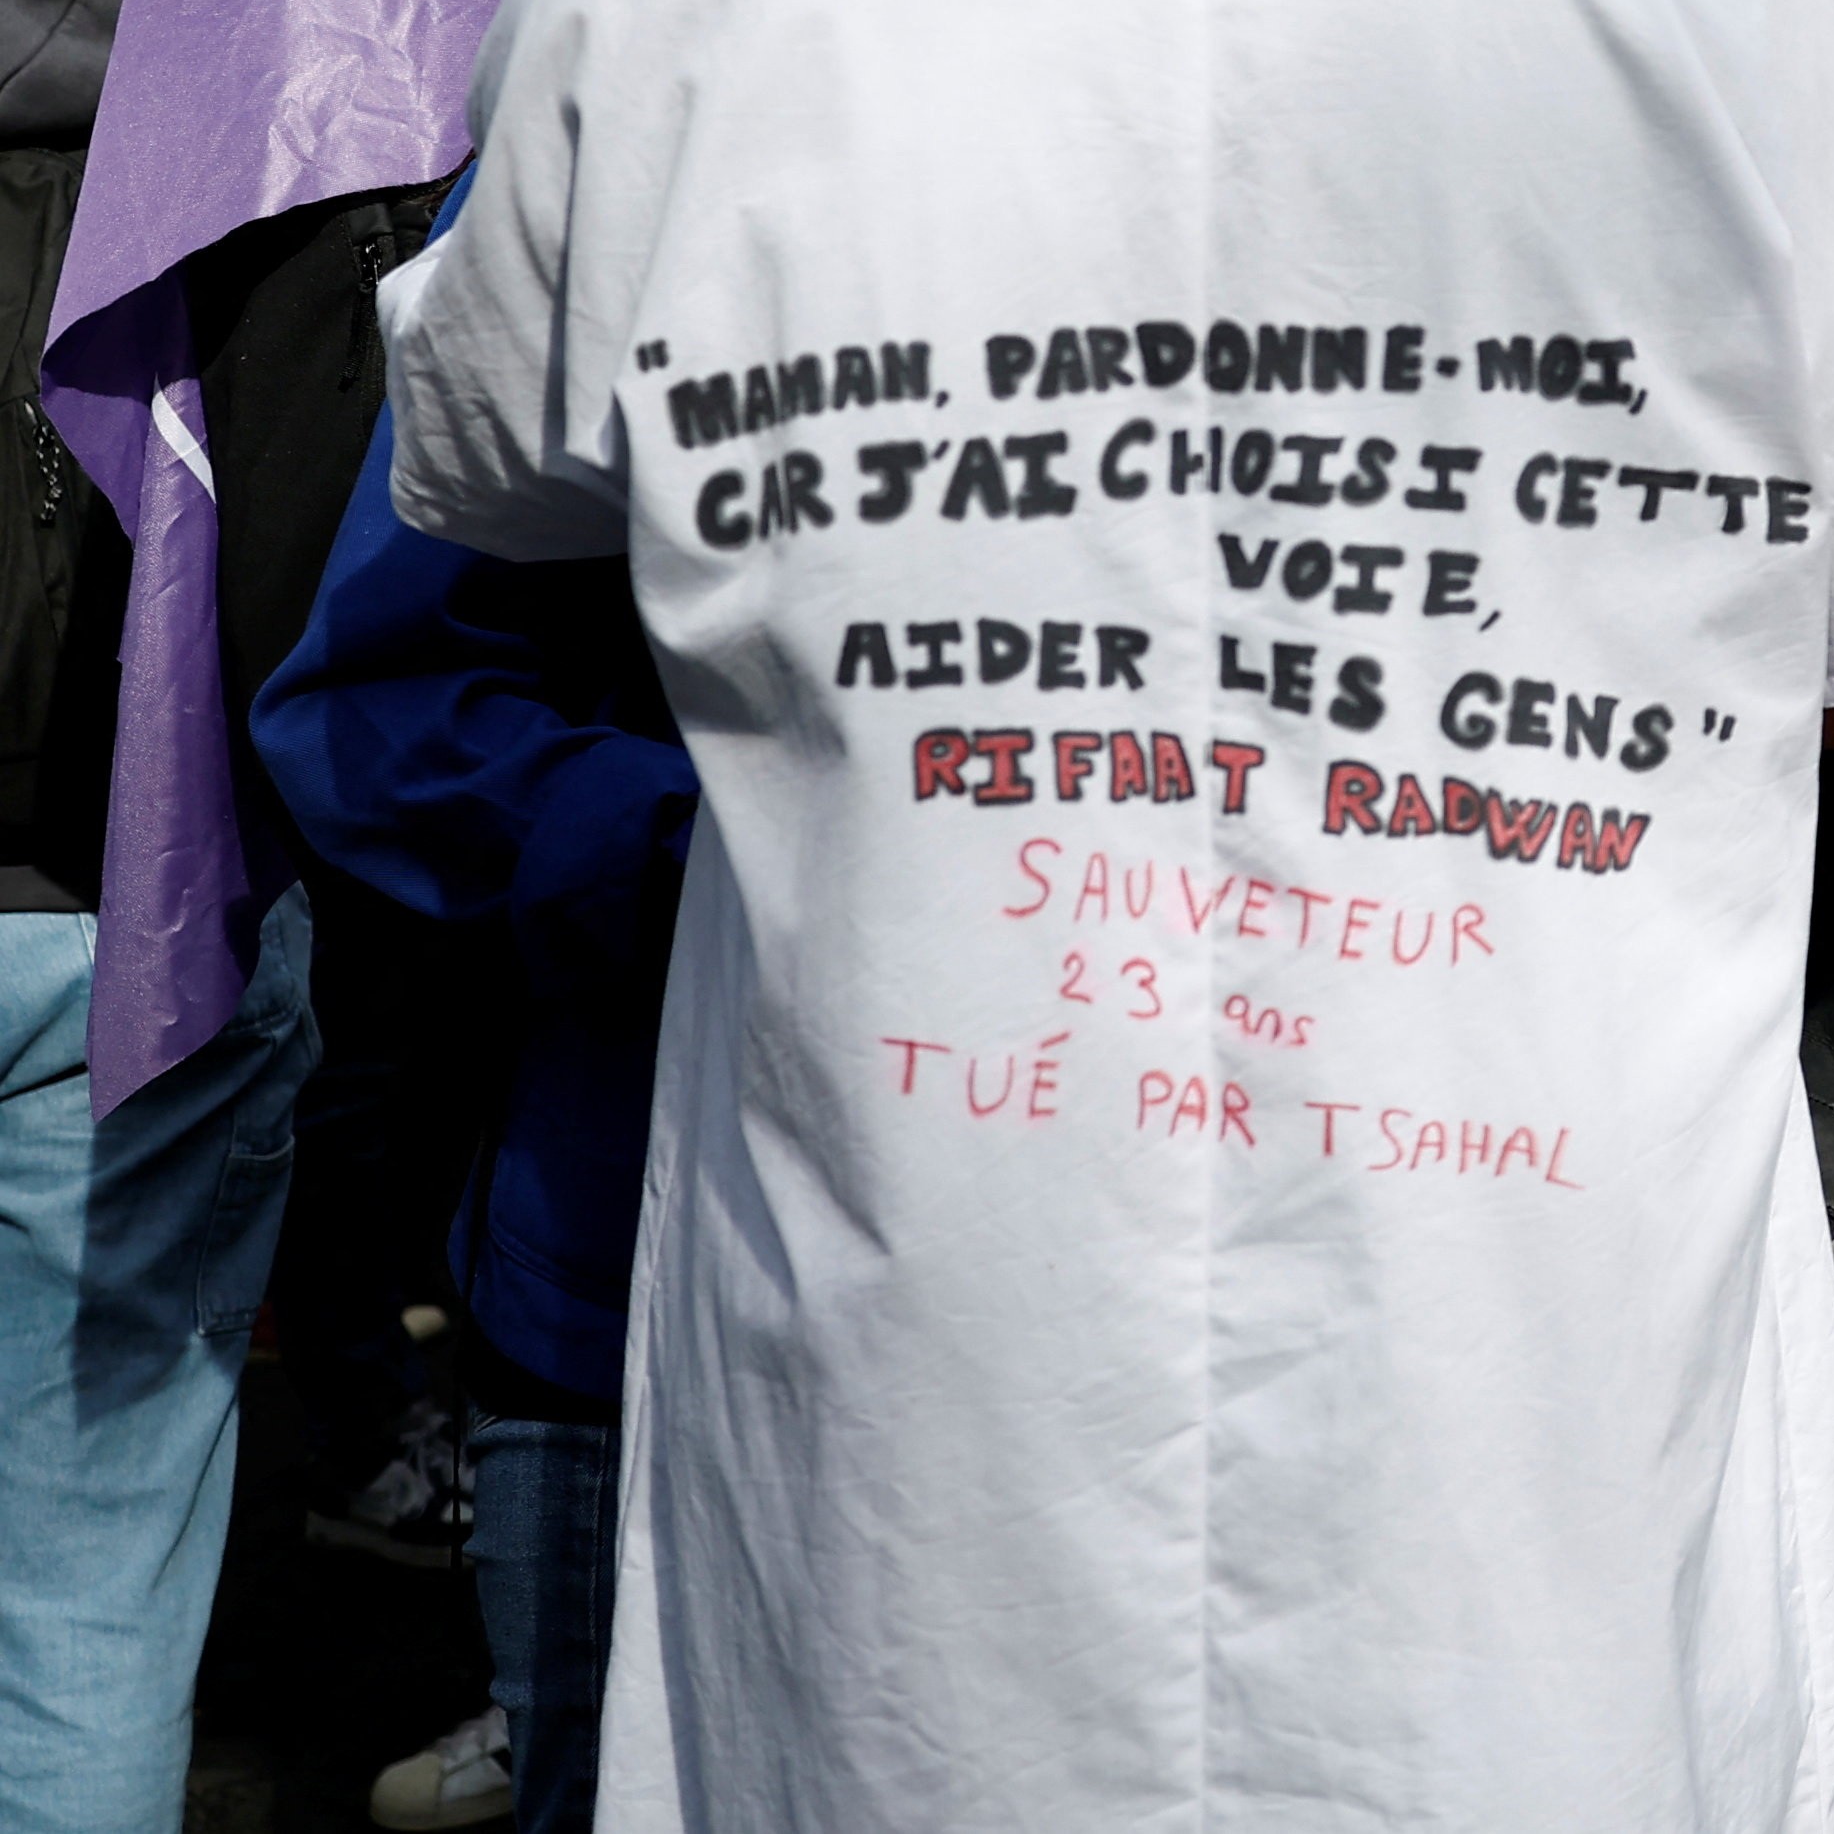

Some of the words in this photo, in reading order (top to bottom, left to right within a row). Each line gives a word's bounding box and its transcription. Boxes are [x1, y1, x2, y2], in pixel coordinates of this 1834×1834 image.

[986, 320, 1649, 413] PARDONNE-MOI,
[694, 457, 835, 550] CAR
[856, 432, 1077, 522] J'AI
[1100, 418, 1482, 512] CHOISI
[1516, 454, 1814, 543] CETTE
[1217, 533, 1502, 632] VOIE,
[836, 619, 1150, 691] AIDER
[1219, 634, 1387, 733] LES
[913, 728, 1265, 814] RIFAAT
[1323, 761, 1651, 873] RADWAN
[1004, 836, 1496, 966] SAUVETEUR
[1060, 952, 1164, 1019] 23
[1223, 992, 1317, 1049] ans
[881, 1032, 1071, 1120] TUÉ
[1136, 1070, 1258, 1148] PAR
[1304, 1102, 1586, 1191] TSAHAL
